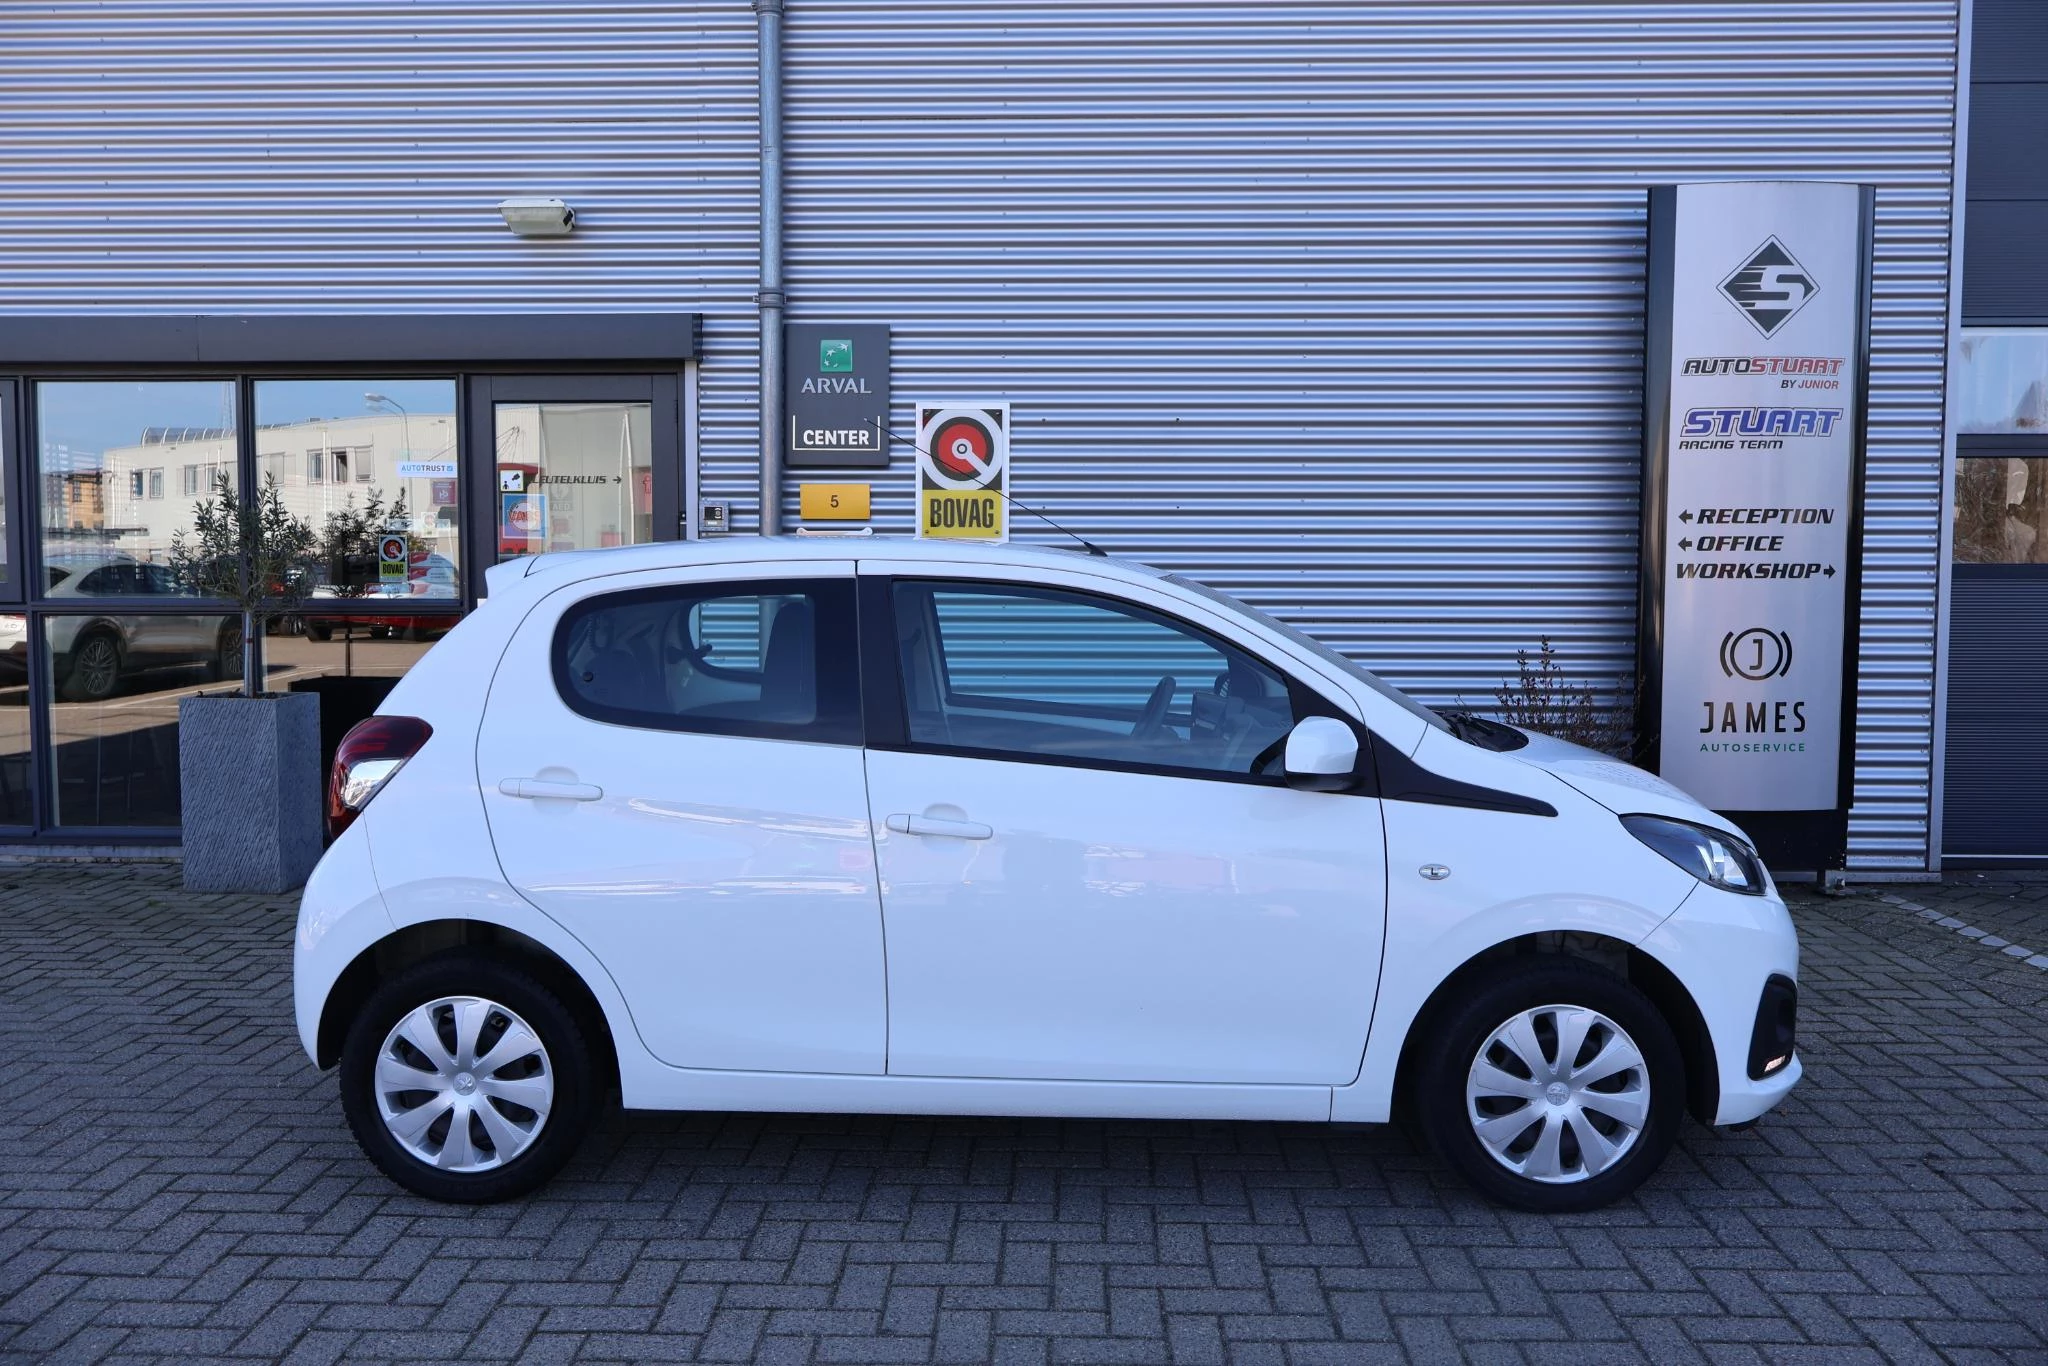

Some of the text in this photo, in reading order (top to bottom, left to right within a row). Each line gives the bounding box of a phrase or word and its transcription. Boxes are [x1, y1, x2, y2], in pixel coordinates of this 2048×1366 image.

[1682, 357, 1845, 376] AUTOSTUART
[801, 377, 872, 394] ARVAL
[1780, 379, 1839, 390] BY JUNIOR
[1681, 408, 1843, 436] STUART
[803, 429, 870, 445] CENTER
[1679, 440, 1783, 450] RACING TEAM
[401, 464, 445, 472] AUTOTRUST
[526, 475, 607, 484] LEUTELKLUIS
[830, 494, 839, 508] 5
[930, 498, 994, 528] BOVAG
[1697, 508, 1835, 524] RECEPTION
[1697, 535, 1784, 552] OFFICE
[382, 563, 404, 574] BOVAG
[1676, 563, 1822, 579] WORKSHOP
[1749, 638, 1763, 670] J
[1700, 701, 1806, 733] JAMES
[1700, 743, 1805, 752] AUTOSERVICE
